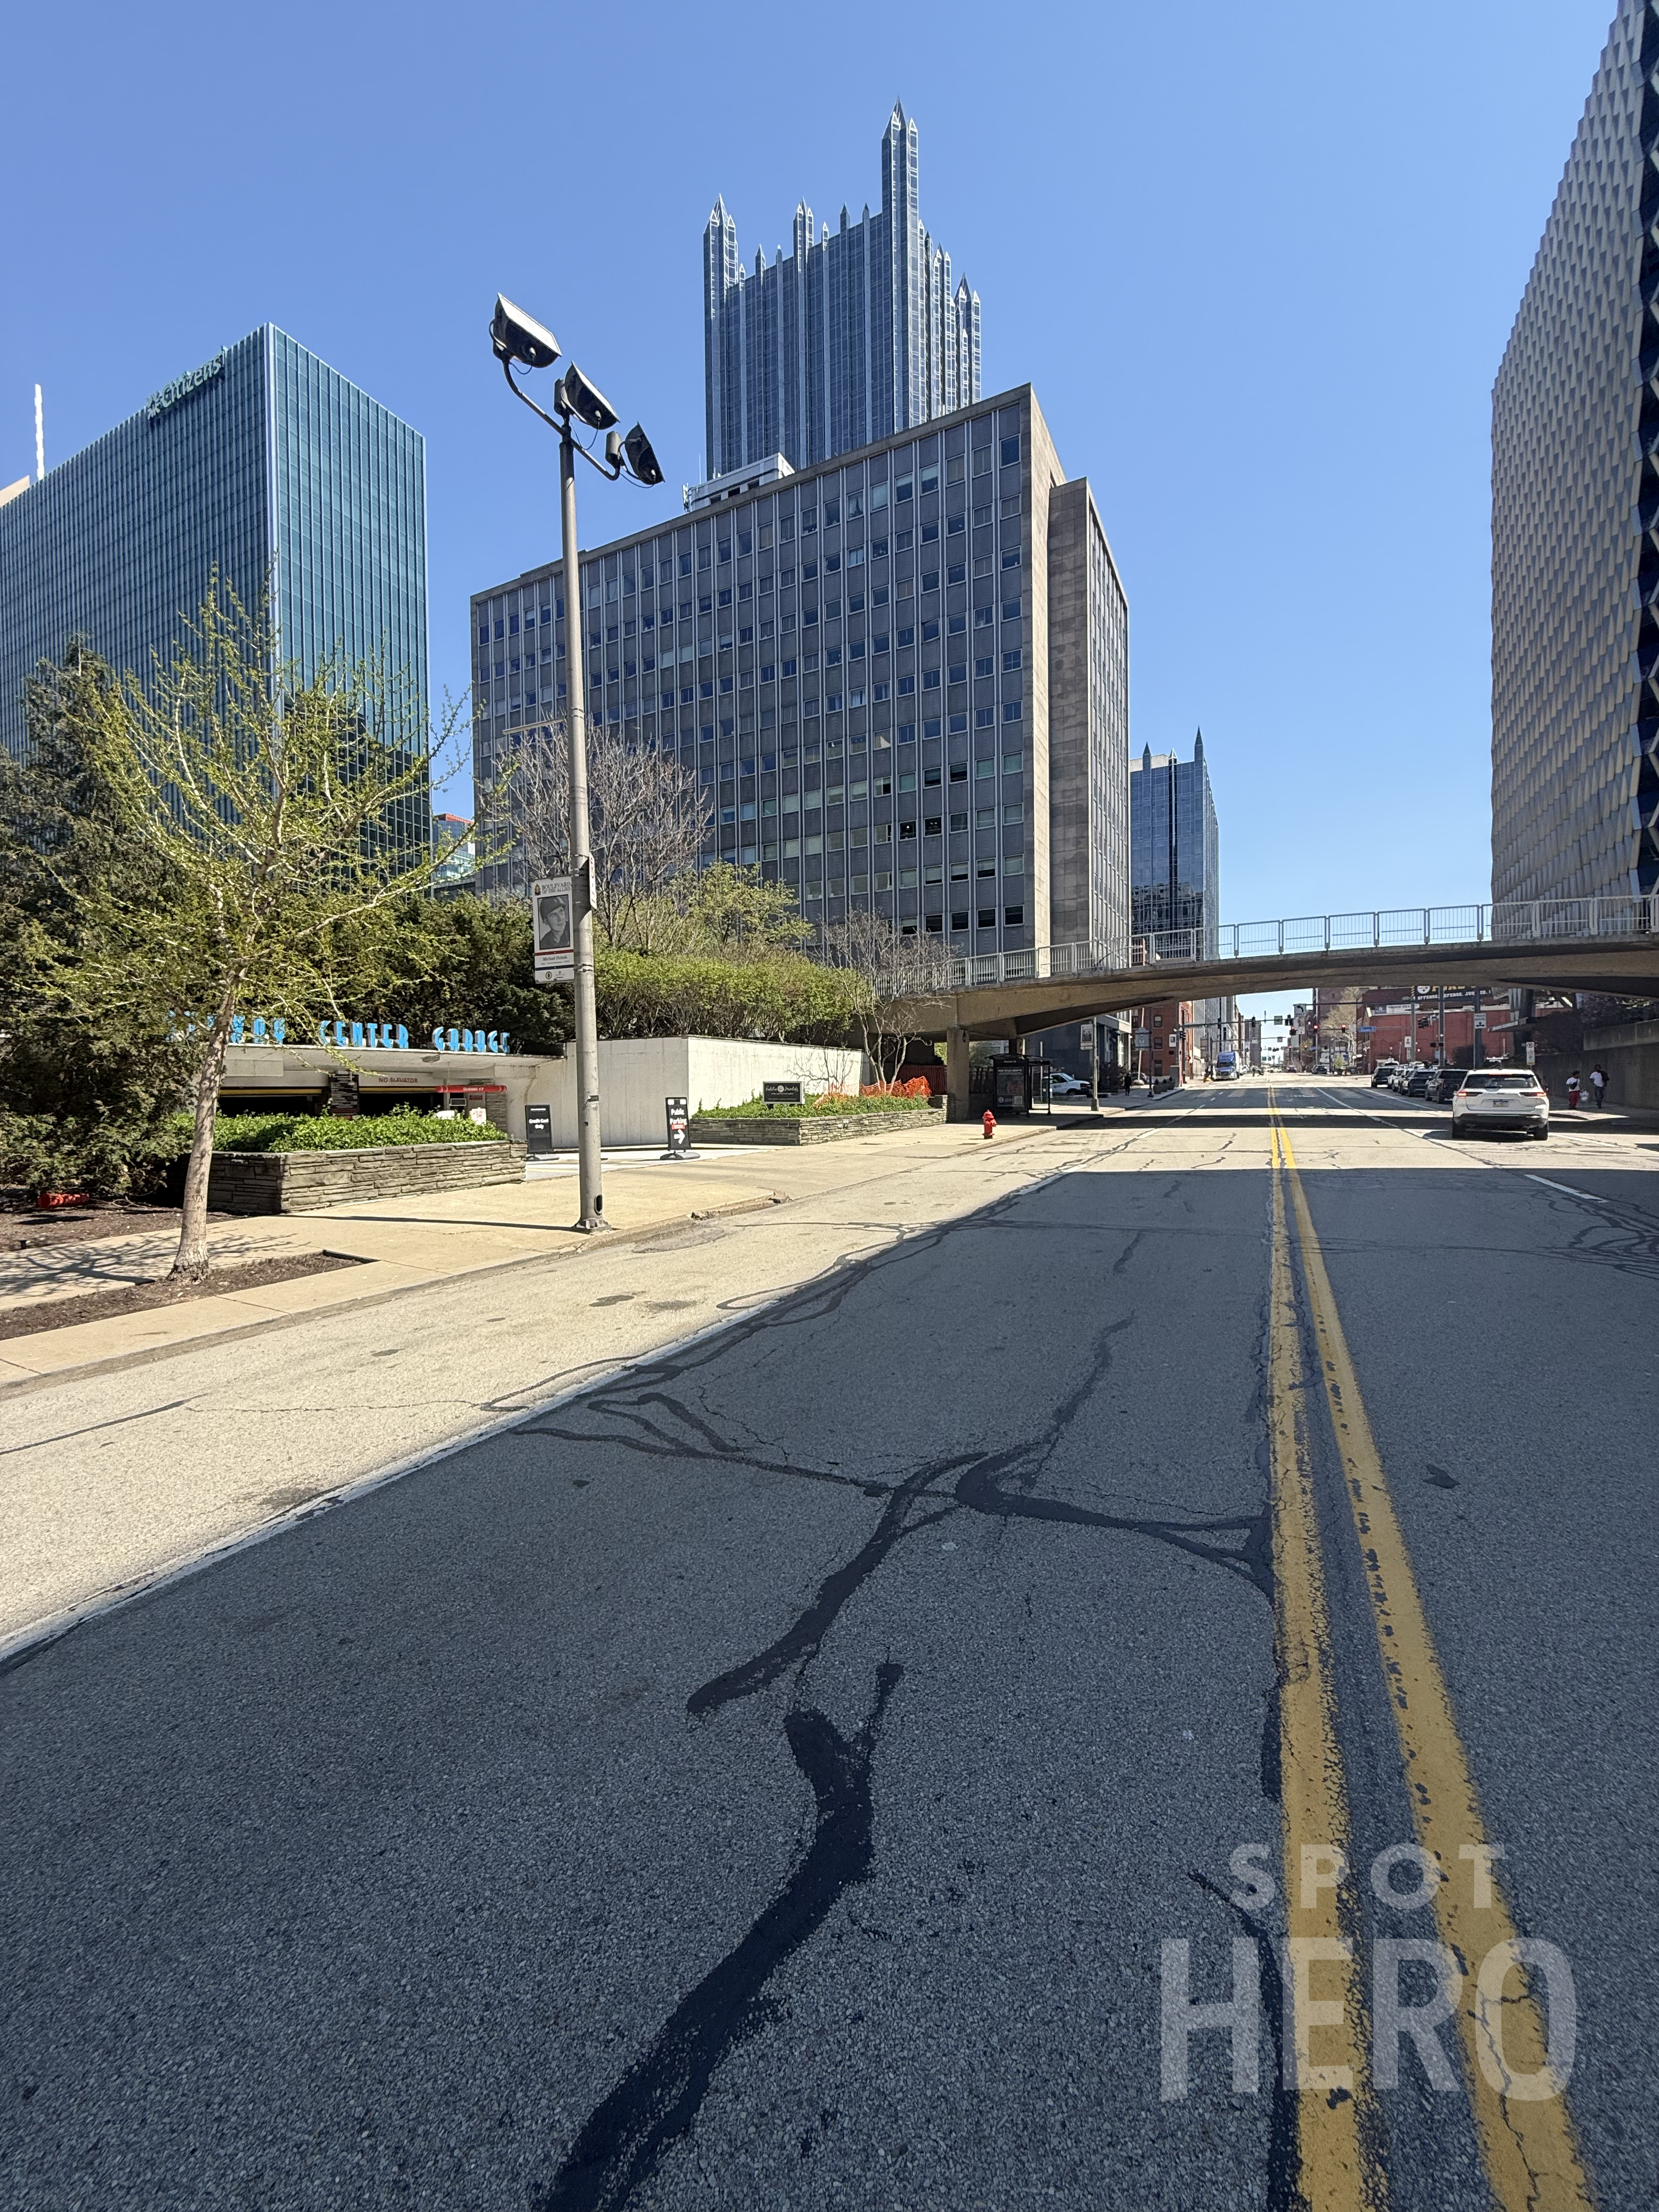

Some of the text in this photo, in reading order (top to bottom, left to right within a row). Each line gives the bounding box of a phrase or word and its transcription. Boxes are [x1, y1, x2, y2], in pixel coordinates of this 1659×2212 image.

[161, 354, 221, 408] Citizens
[541, 882, 571, 890] BOULEVARD
[318, 1020, 409, 1049] CENTER
[432, 1026, 510, 1054] GARAGE
[669, 1117, 687, 1126] Parking
